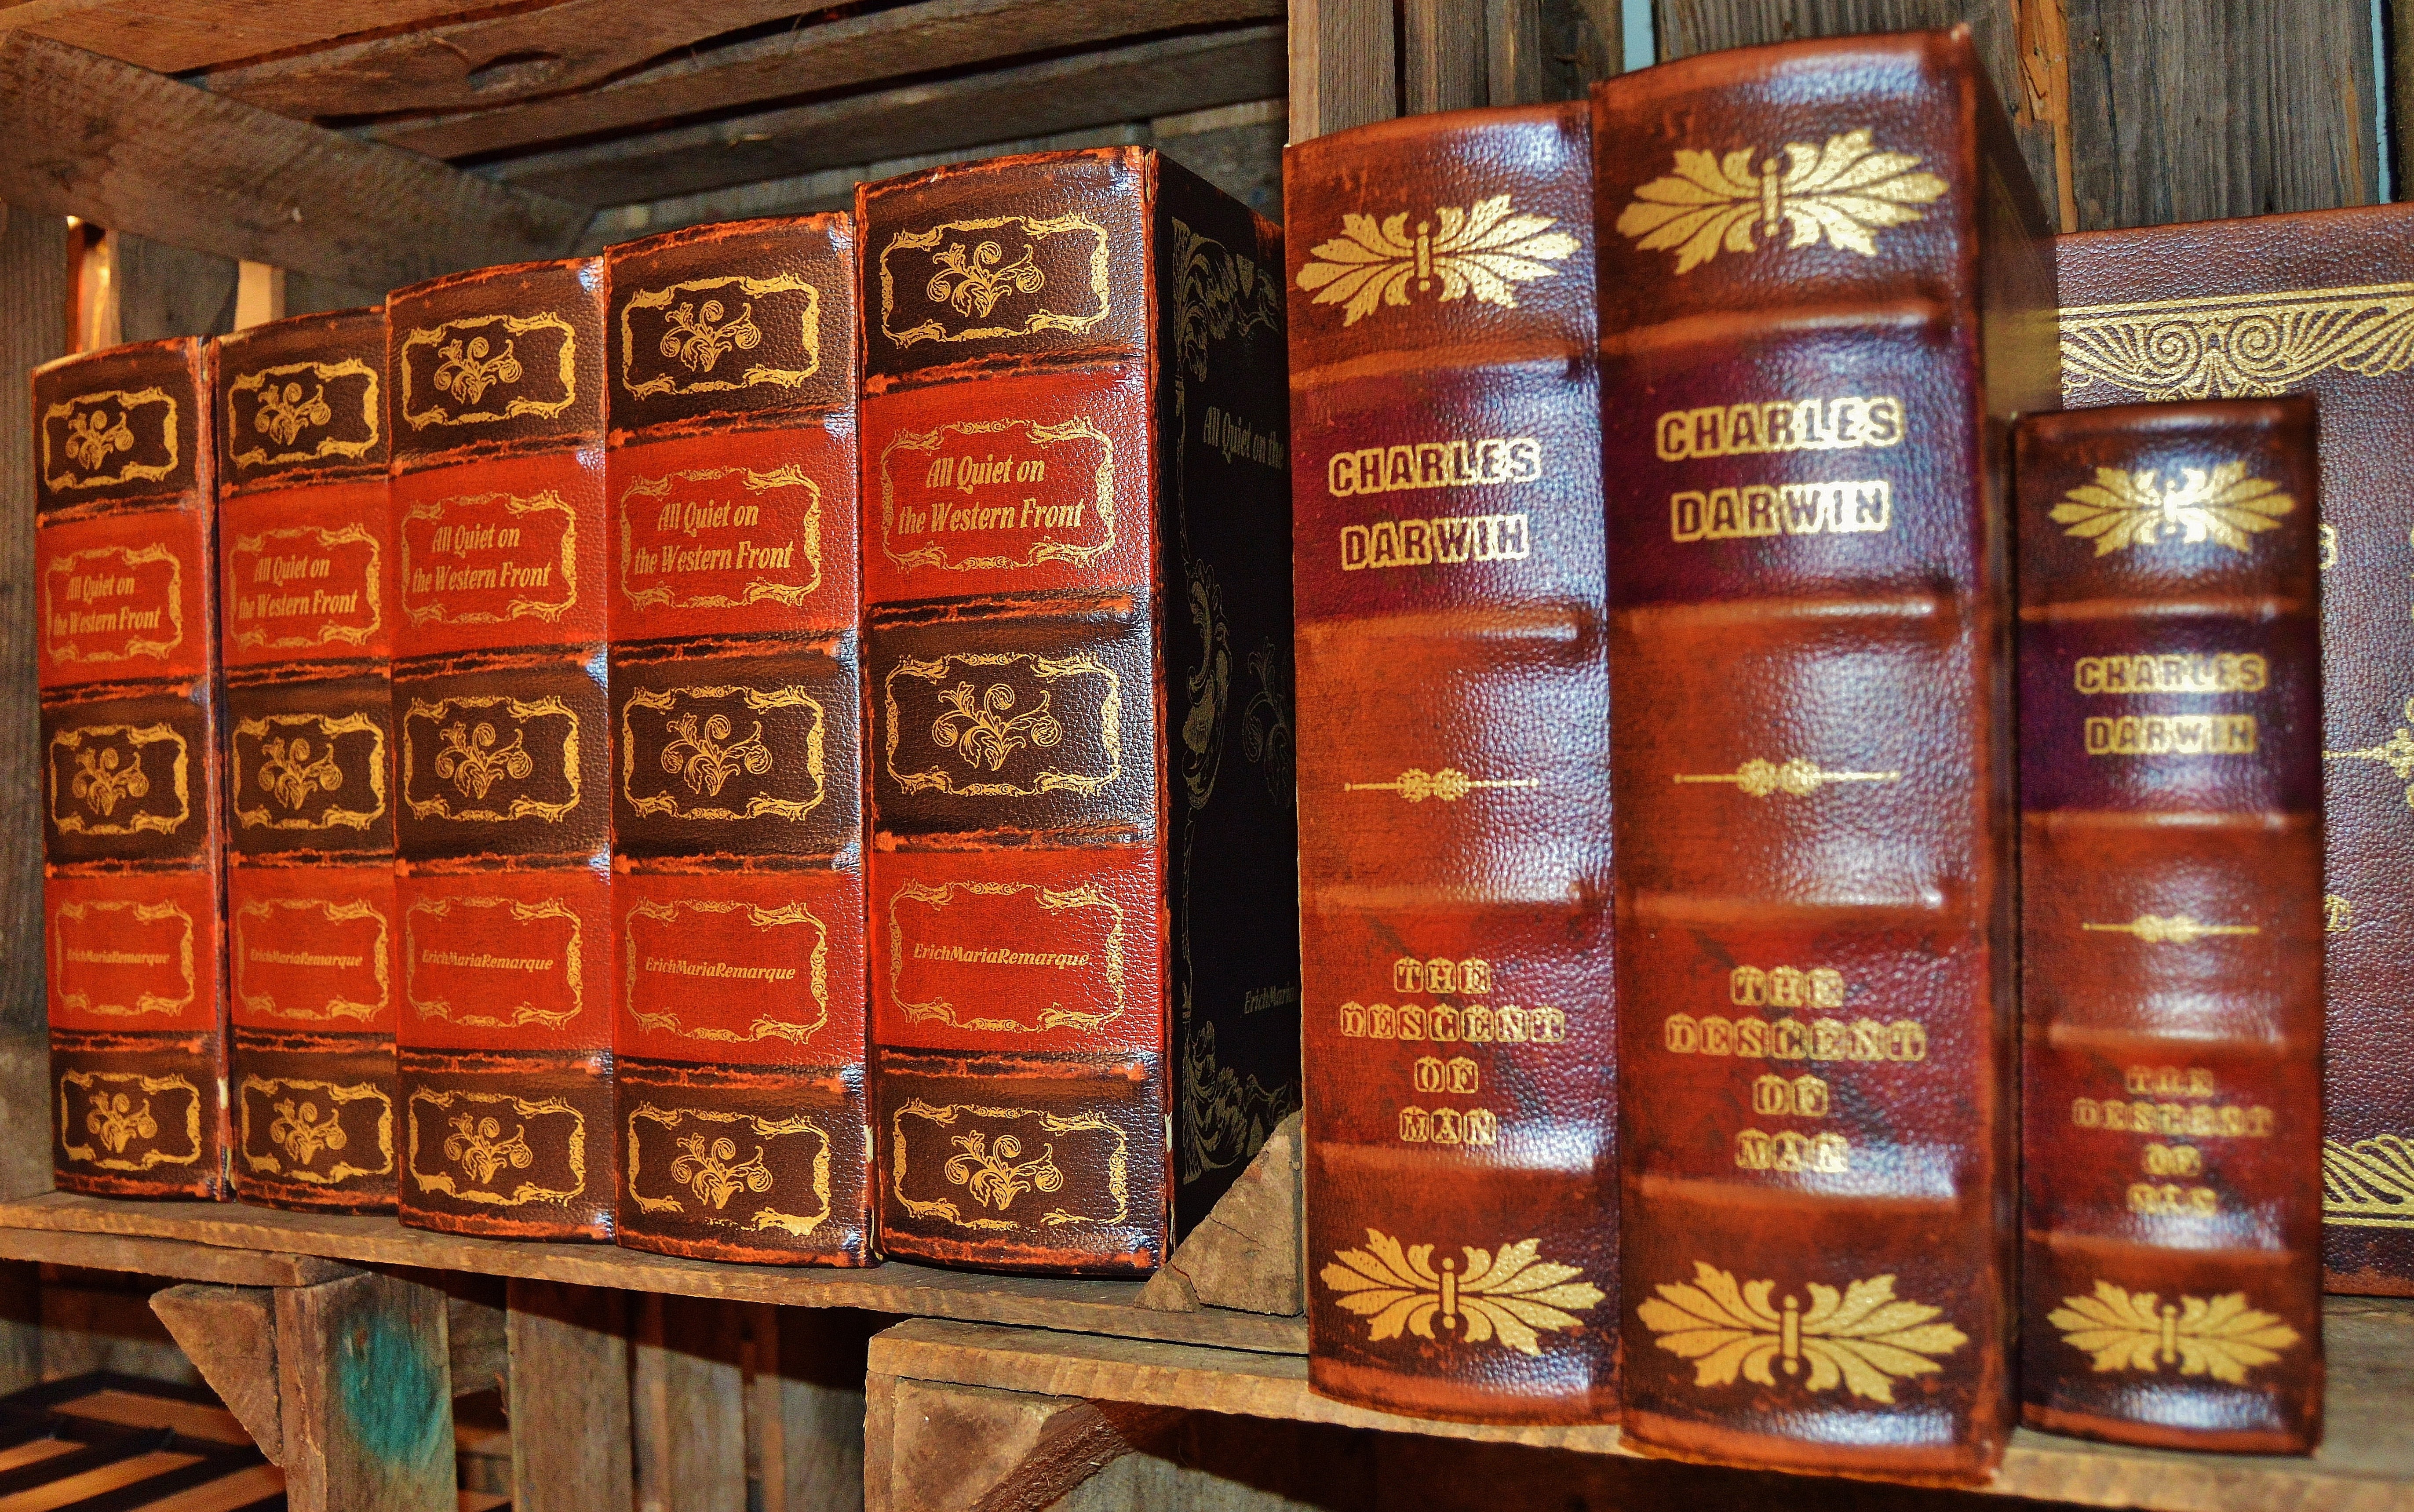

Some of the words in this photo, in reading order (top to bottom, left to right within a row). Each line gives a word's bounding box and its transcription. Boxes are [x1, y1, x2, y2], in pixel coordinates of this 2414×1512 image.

[1204, 406, 1220, 446] All
[1222, 412, 1251, 463] Quiet
[1254, 434, 1267, 462] on
[1268, 431, 1284, 470] the
[1656, 396, 1902, 461] CHARLES
[926, 457, 953, 487] All
[957, 454, 1013, 494] Quiet
[1017, 460, 1045, 483] on
[1328, 438, 1540, 496] CHARLES
[658, 503, 681, 531] All
[683, 499, 730, 537] Quiet
[733, 505, 758, 526] on
[898, 506, 926, 535] the
[931, 502, 1015, 531] Western
[1021, 498, 1085, 529] Front
[1671, 481, 1888, 542] DARWIN
[434, 527, 452, 552] All
[455, 525, 494, 558] Quiet
[498, 528, 520, 547] on
[634, 547, 658, 574] the
[662, 543, 733, 572] Western
[736, 540, 794, 569] Front
[1341, 514, 1529, 570] DARWIN
[254, 557, 271, 582] All
[273, 554, 307, 587] Quiet
[310, 558, 331, 577] on
[413, 566, 431, 592] the
[435, 565, 496, 590] Western
[500, 561, 551, 587] Front
[257, 594, 310, 617] Western
[314, 589, 357, 613] Front
[2074, 653, 2268, 694] CHARLES
[2085, 715, 2257, 755] DARWIN
[645, 957, 795, 983] ErichMariaRemarque
[913, 944, 1089, 969] ErichMariaRemarque
[1393, 956, 1492, 994] THE
[1733, 965, 1844, 1009] THE
[1339, 1002, 1565, 1042] DESCENT
[1666, 1013, 1926, 1060] DESCENT
[1415, 1055, 1479, 1093] OF
[1752, 1073, 1827, 1117] OF
[1399, 1105, 1496, 1145] MAN
[1734, 1128, 1847, 1172] MAN
